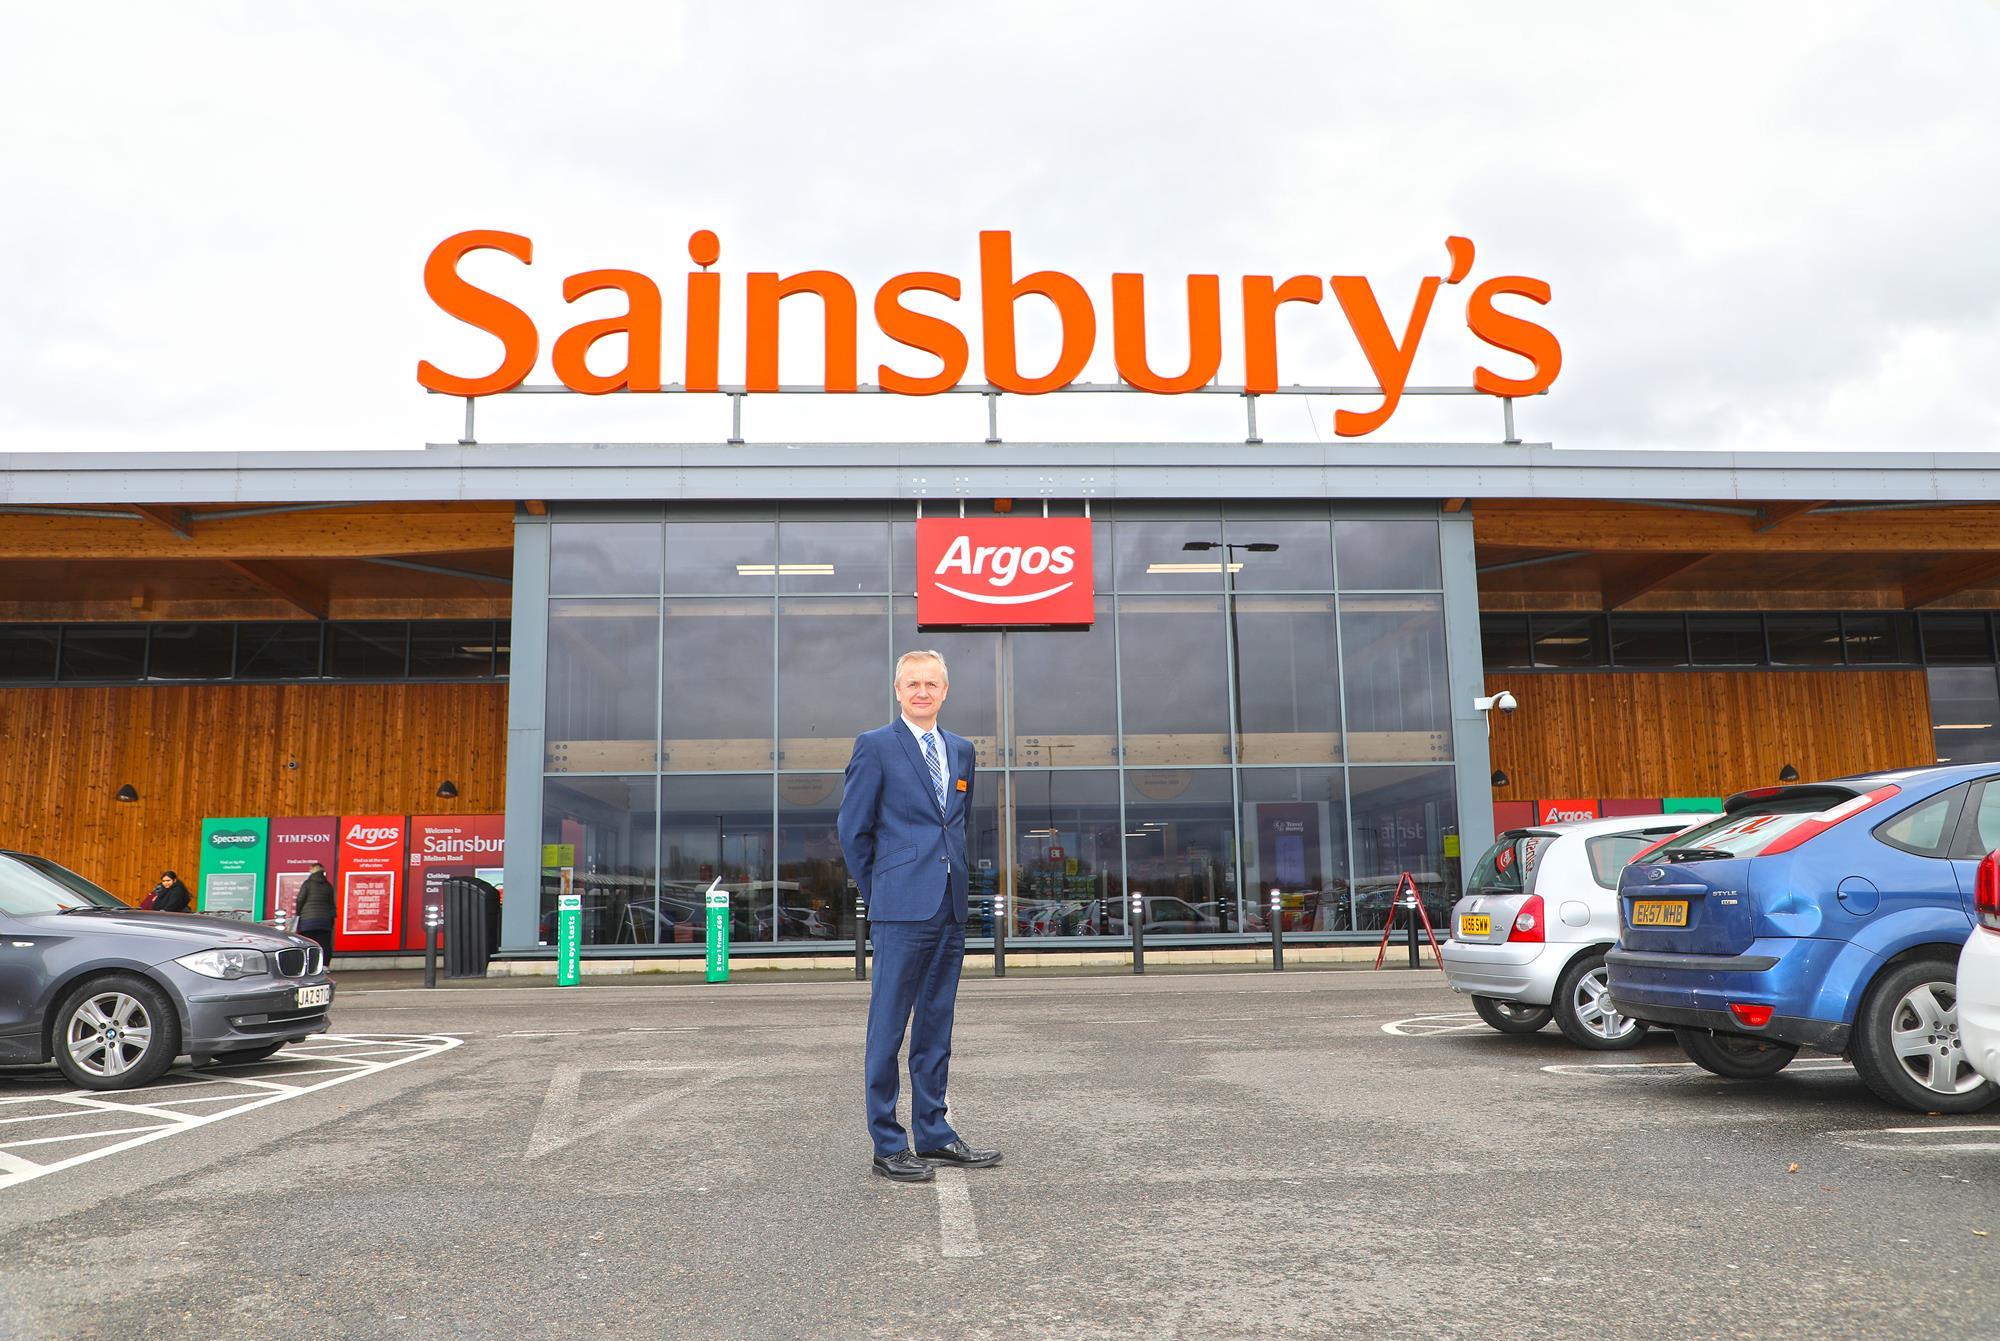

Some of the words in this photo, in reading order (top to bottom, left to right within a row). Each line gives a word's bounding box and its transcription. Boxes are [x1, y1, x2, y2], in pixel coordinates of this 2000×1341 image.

[417, 229, 1563, 436] Sainsbury's
[934, 536, 1076, 587] Argos
[1545, 807, 1593, 822] Argos
[212, 834, 256, 844] Specsavers
[277, 834, 331, 843] TIMPSON
[346, 824, 400, 844] Argos
[423, 854, 447, 862] Melton
[447, 854, 464, 862] Road
[1637, 904, 1662, 923] EK57
[1663, 904, 1683, 924] WHB
[568, 916, 576, 940] tests
[567, 959, 575, 979] Free
[299, 990, 314, 1006] JAZ
